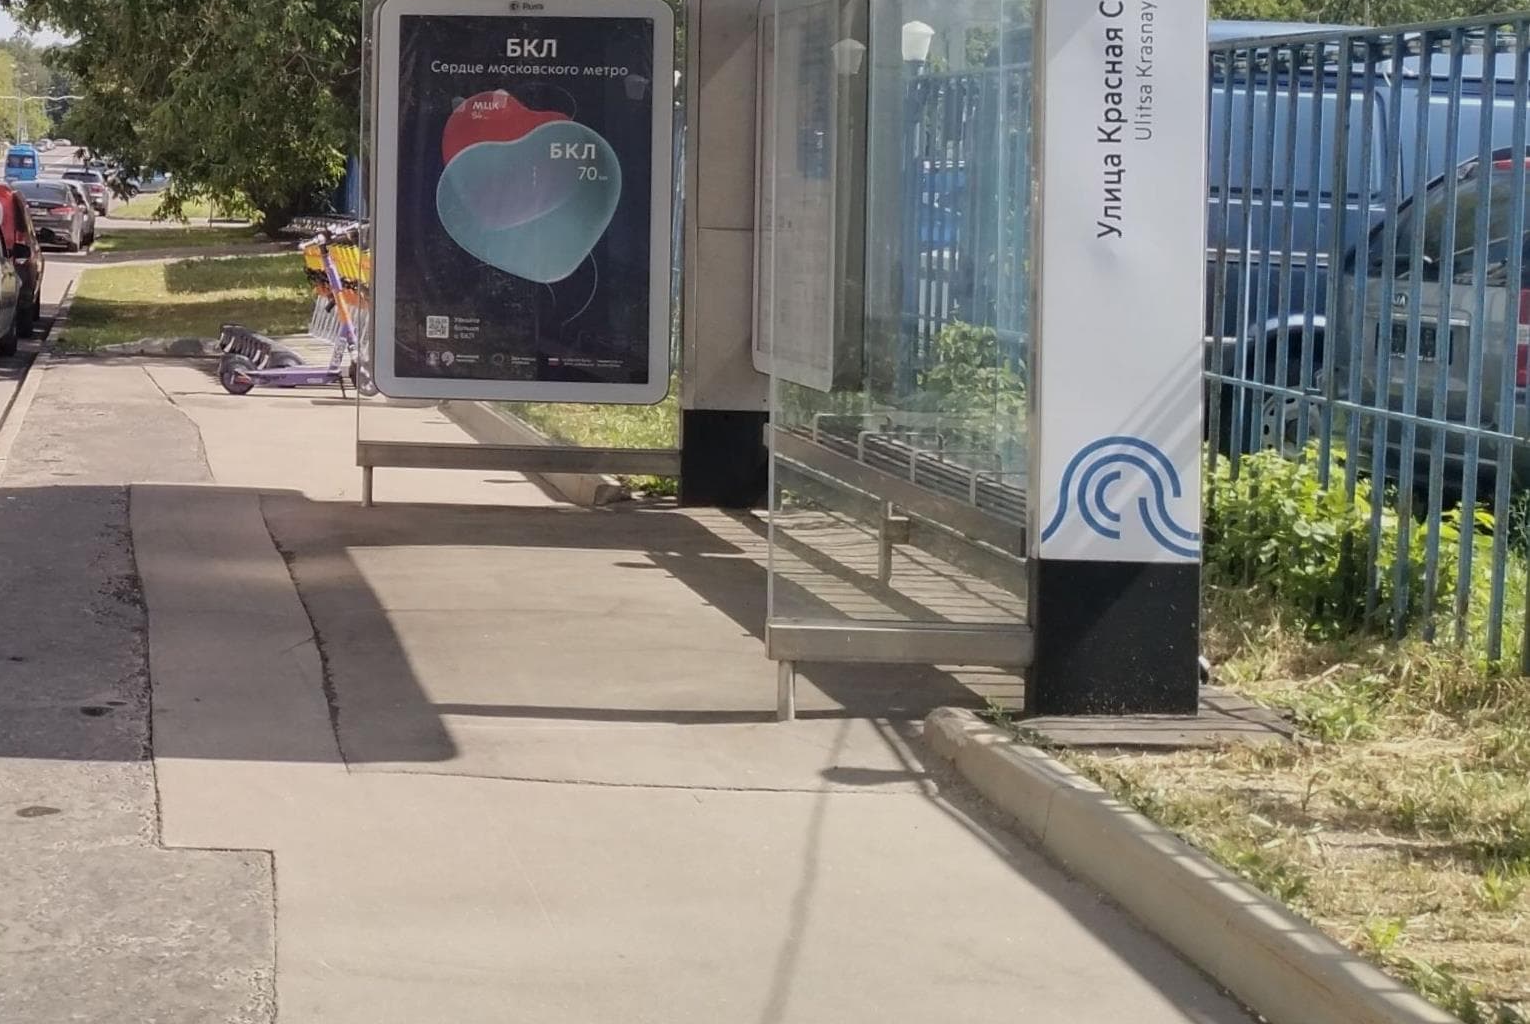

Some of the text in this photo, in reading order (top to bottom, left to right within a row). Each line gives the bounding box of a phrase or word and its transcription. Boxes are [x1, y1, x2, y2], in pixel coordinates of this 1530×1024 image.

[506, 38, 559, 58] БКЛ
[431, 60, 630, 79] Сердце московского метро
[1097, 28, 1128, 143] Красная
[1134, 84, 1153, 140] Ulitsa
[549, 143, 597, 160] БКЛ
[577, 166, 598, 181] 70
[1096, 154, 1126, 239] Улица
